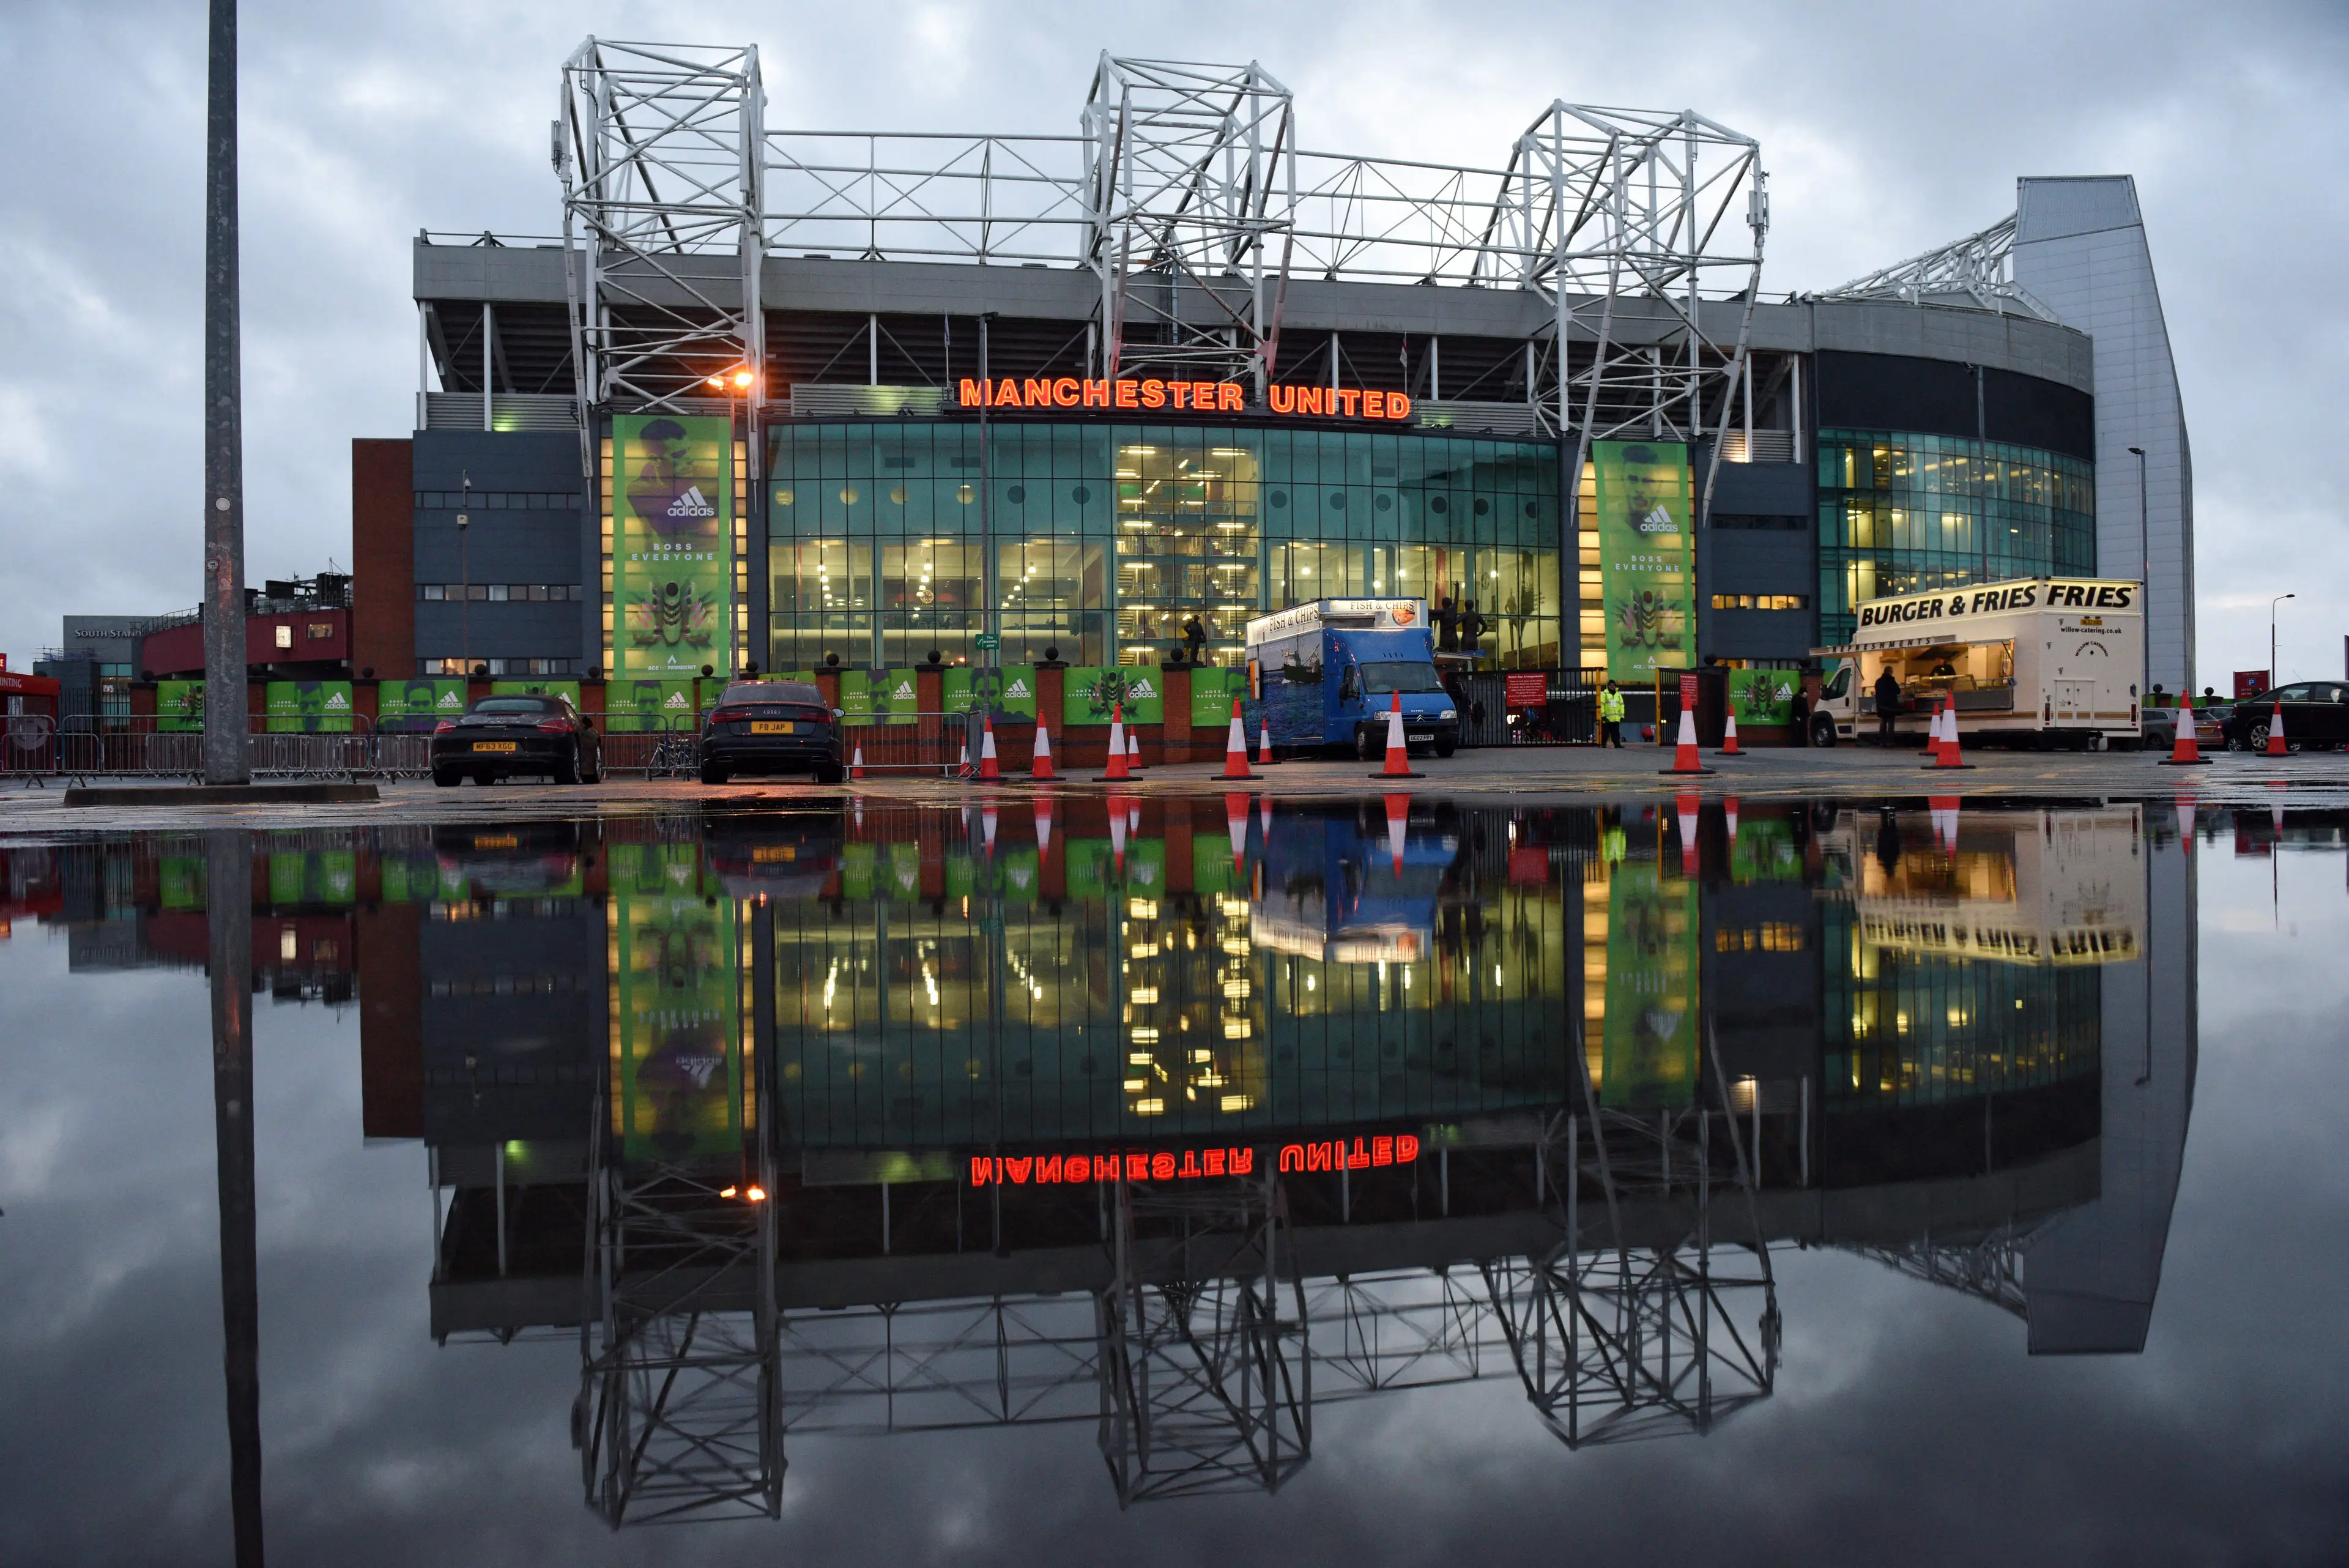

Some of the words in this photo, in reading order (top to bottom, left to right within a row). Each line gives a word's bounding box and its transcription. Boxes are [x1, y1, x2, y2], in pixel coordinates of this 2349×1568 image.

[960, 377, 1244, 411] MANCHESTER
[1269, 385, 1411, 419] UNITED
[667, 505, 714, 516] adidas
[1640, 522, 1679, 532] adidas
[631, 552, 713, 561] EVERYONE
[1615, 563, 1679, 572] EVERYONE
[2046, 585, 2132, 608] FRIES
[1350, 601, 1373, 610] FISH
[1376, 601, 1383, 610] &
[1386, 601, 1414, 610] CHIPS
[1861, 598, 1943, 626] BURGER
[1948, 595, 1965, 615] &
[1971, 585, 2037, 613] FRIES
[1269, 614, 1285, 632] FISH
[1287, 615, 1294, 627] &
[1295, 604, 1319, 625] CHIPS
[75, 629, 108, 637] SOUTH
[110, 629, 142, 638] STAND
[2060, 626, 2122, 635] willow-catering.co.uk
[1832, 637, 1932, 653] REFRESHMENTS
[2075, 641, 2090, 657] WILLOW
[2090, 641, 2109, 657] CATERING
[1129, 690, 1157, 699] adidas
